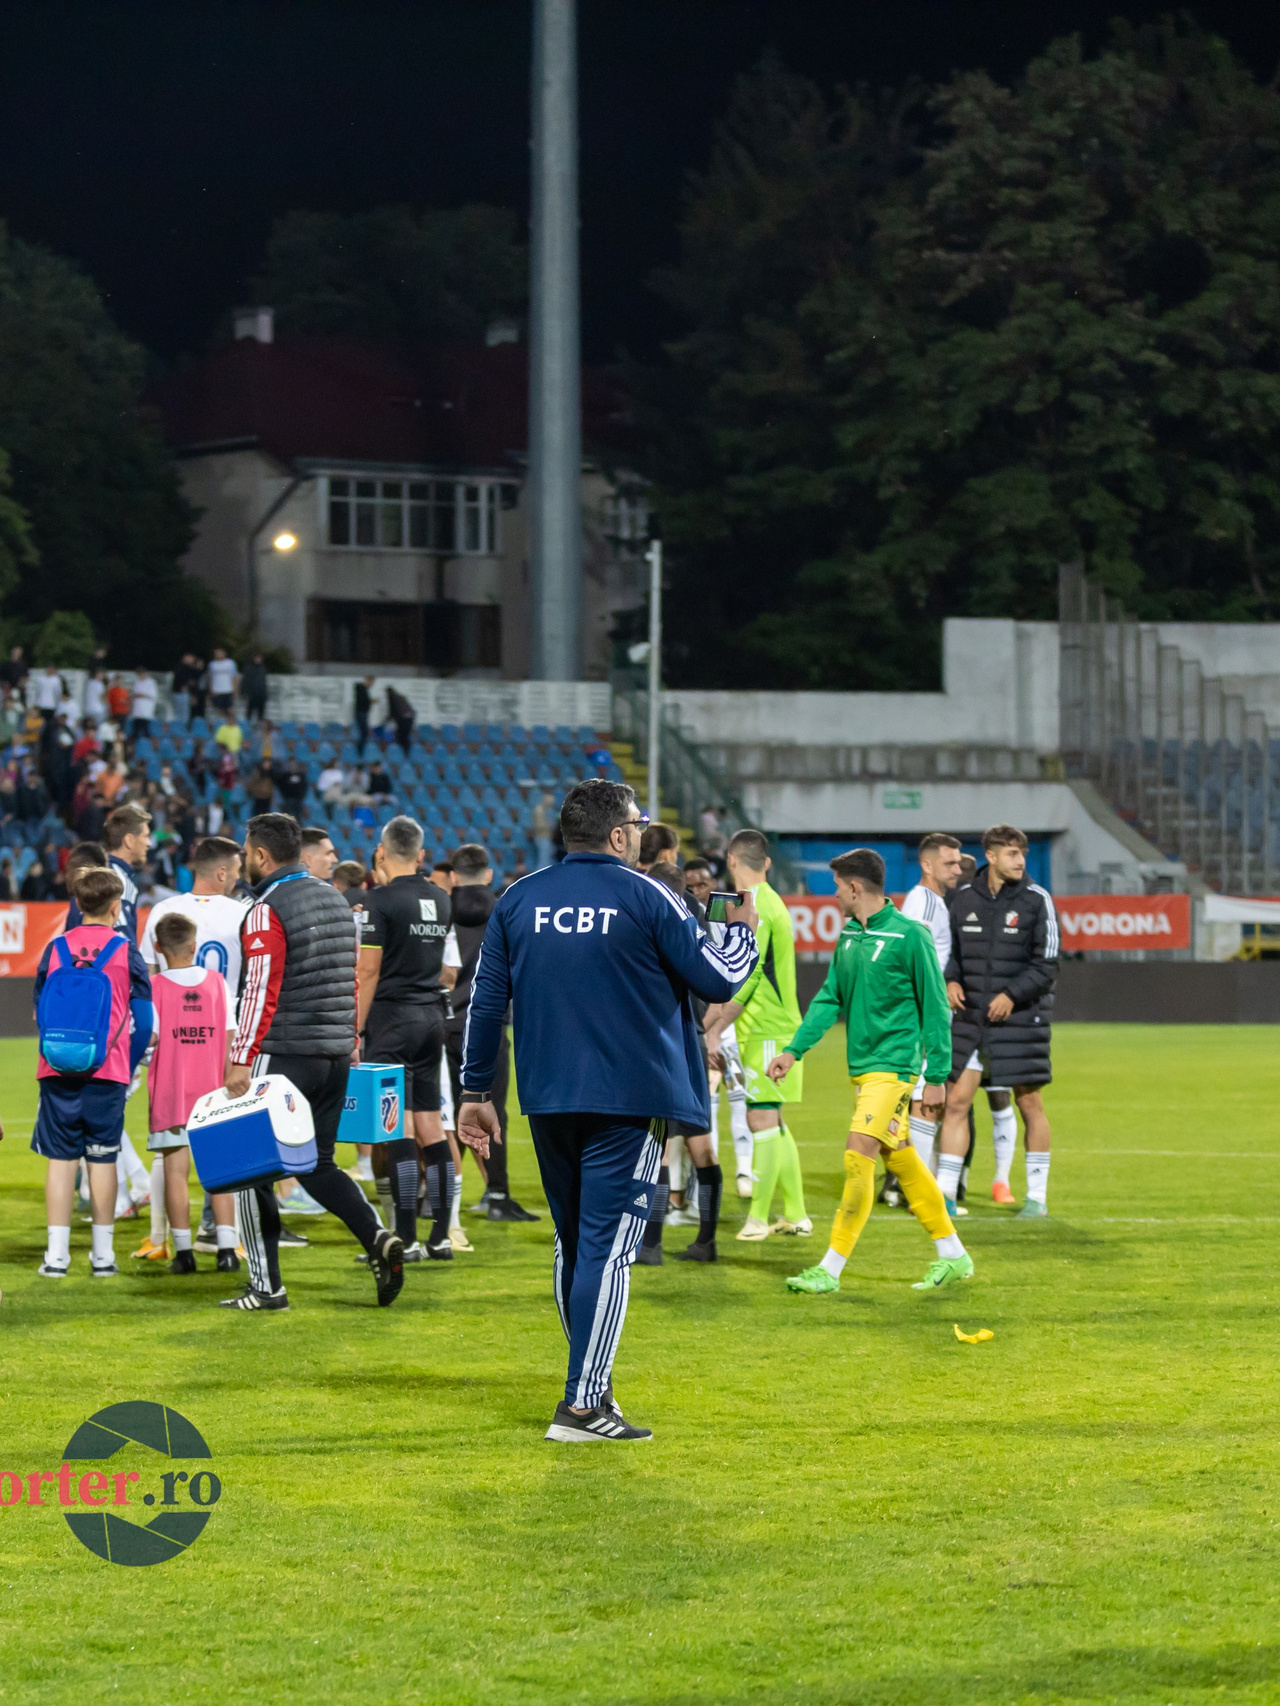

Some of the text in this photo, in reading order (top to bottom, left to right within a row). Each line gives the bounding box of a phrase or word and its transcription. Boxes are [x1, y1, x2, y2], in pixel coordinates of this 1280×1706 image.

[409, 923, 448, 936] NORDIS
[534, 906, 618, 935] FCBT
[1061, 912, 1172, 936] VORONA
[344, 1097, 357, 1110] US
